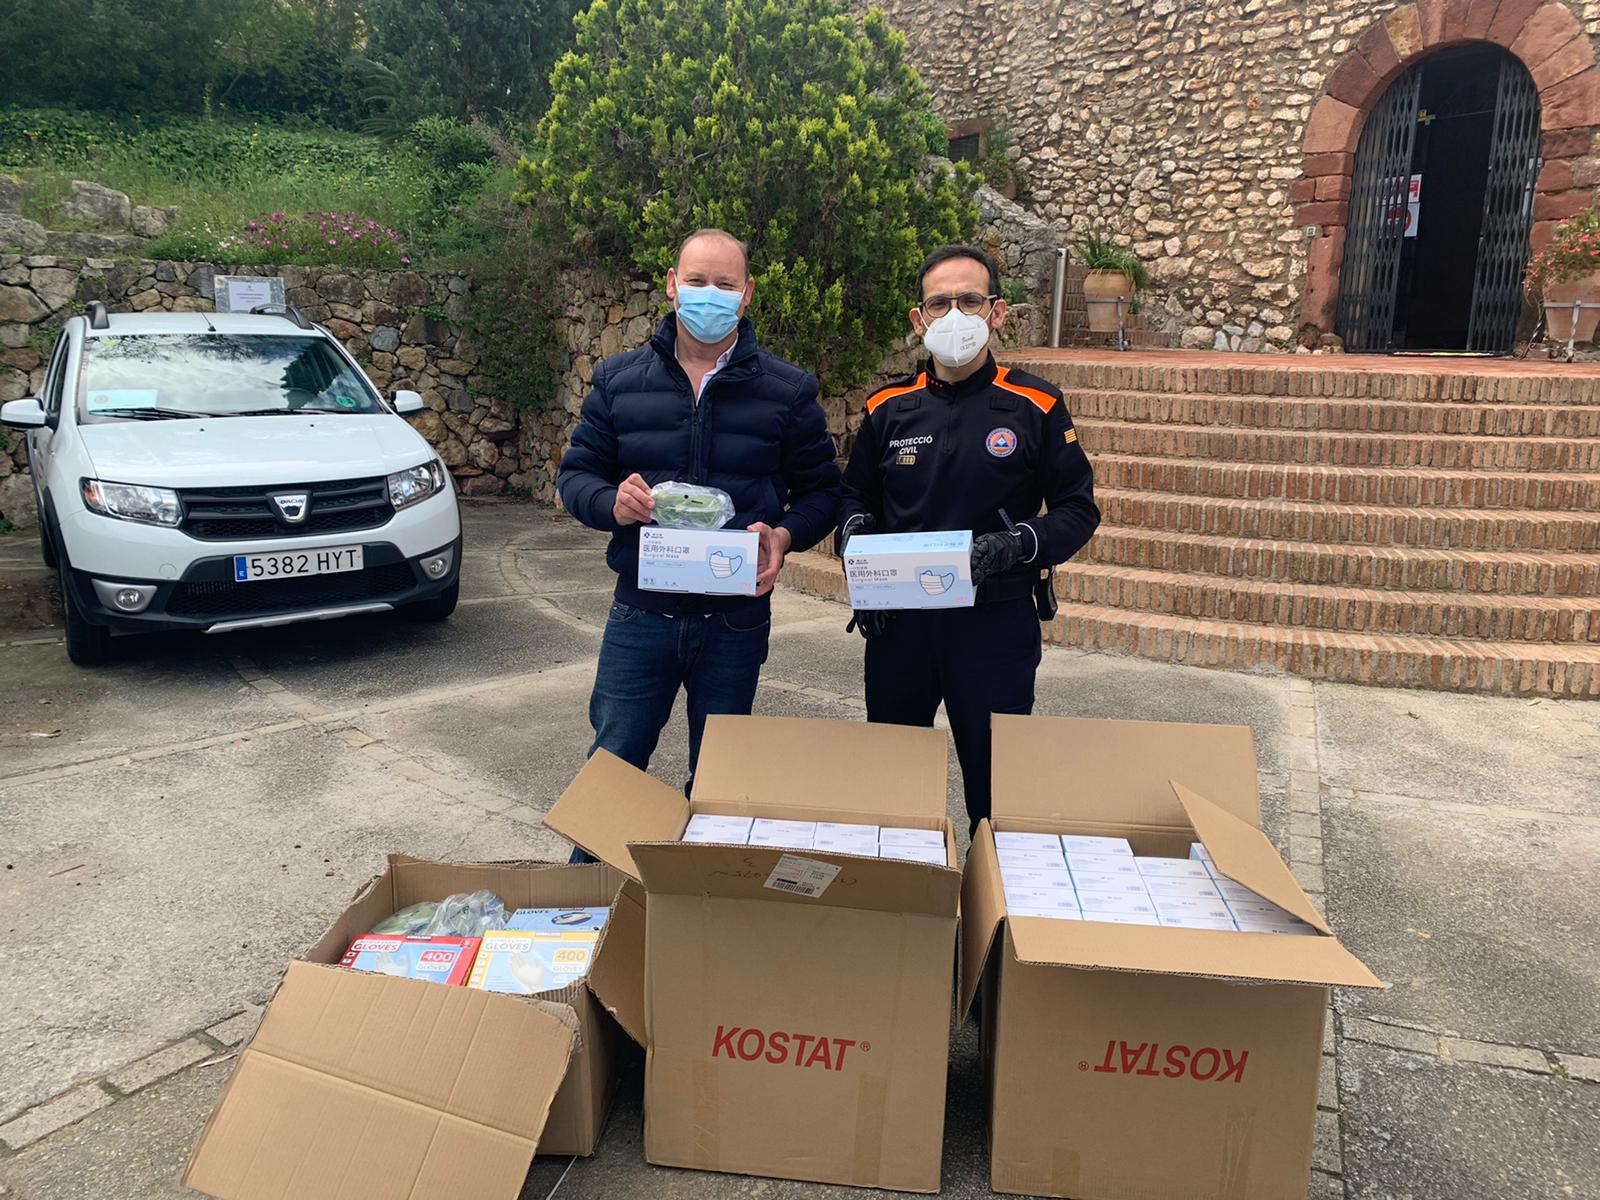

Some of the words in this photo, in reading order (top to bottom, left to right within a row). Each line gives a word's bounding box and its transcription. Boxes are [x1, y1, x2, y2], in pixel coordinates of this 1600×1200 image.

[889, 435, 933, 448] PROTECCIÓ
[899, 446, 918, 454] CIVIL
[643, 544, 690, 554] 医用外科口罩
[251, 555, 309, 577] 5382
[317, 549, 357, 571] HYT
[849, 568, 898, 577] 医用外科口罩
[353, 942, 398, 951] GLOVES
[484, 942, 529, 950] GLOVES
[423, 952, 453, 961] 400
[553, 951, 585, 961] 400
[711, 1025, 856, 1071] KOSTAT
[1093, 1040, 1249, 1083] KOSTAT
